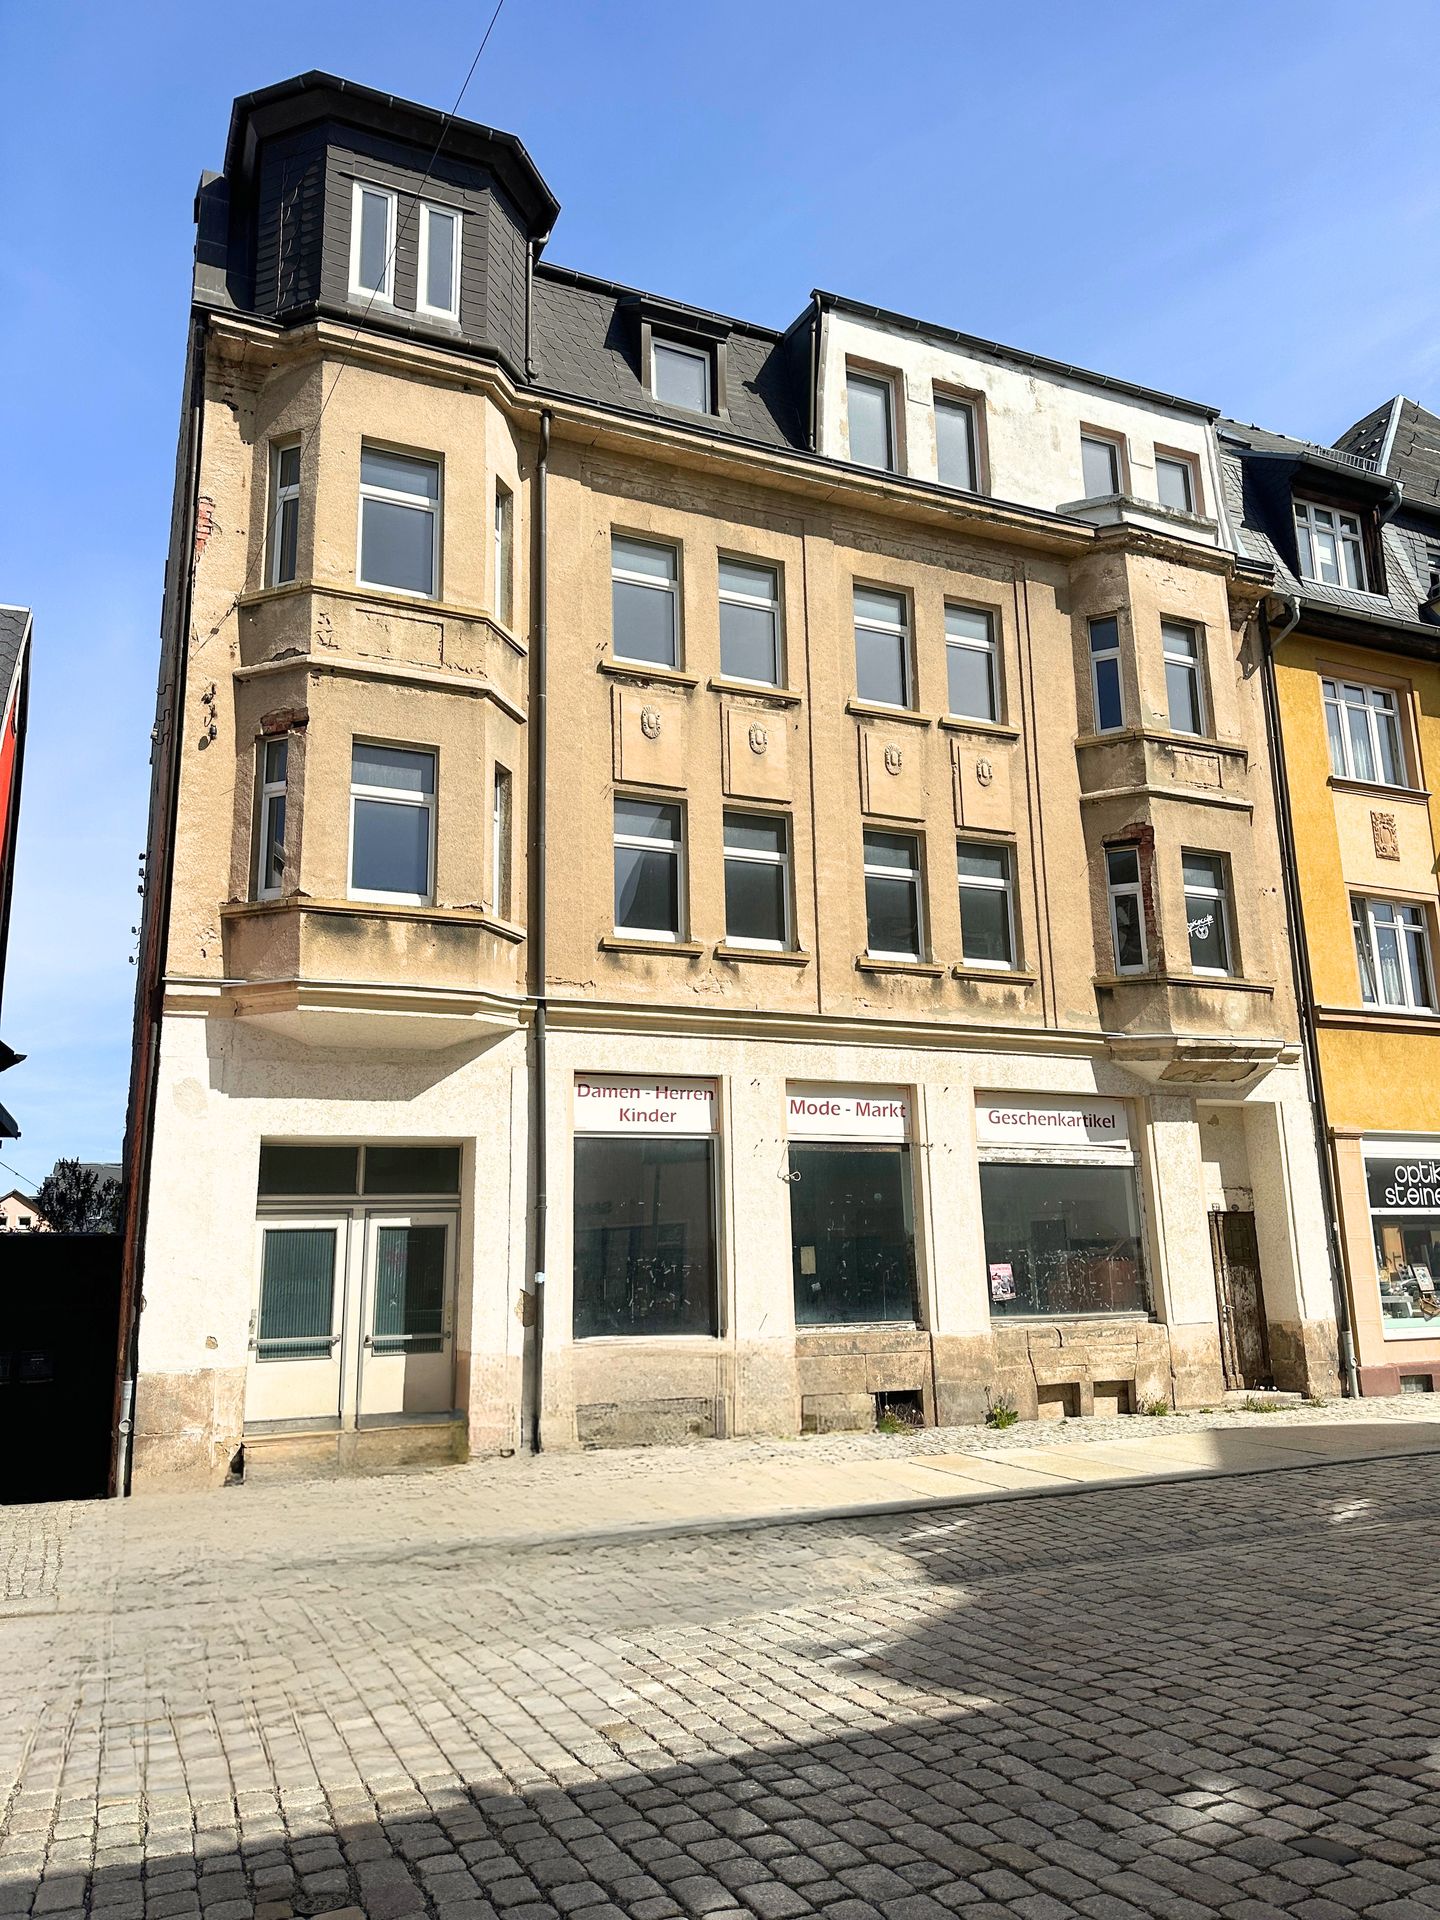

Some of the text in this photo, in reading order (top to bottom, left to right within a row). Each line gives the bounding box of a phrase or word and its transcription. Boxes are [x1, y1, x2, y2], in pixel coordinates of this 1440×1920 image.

[577, 1083, 640, 1099] Damen
[655, 1085, 714, 1101] Herren
[619, 1107, 677, 1123] Kinder
[790, 1099, 841, 1116] Mode
[856, 1101, 906, 1118] Markt
[988, 1109, 1115, 1129] Geschenkartikel
[1394, 1161, 1440, 1187] optik
